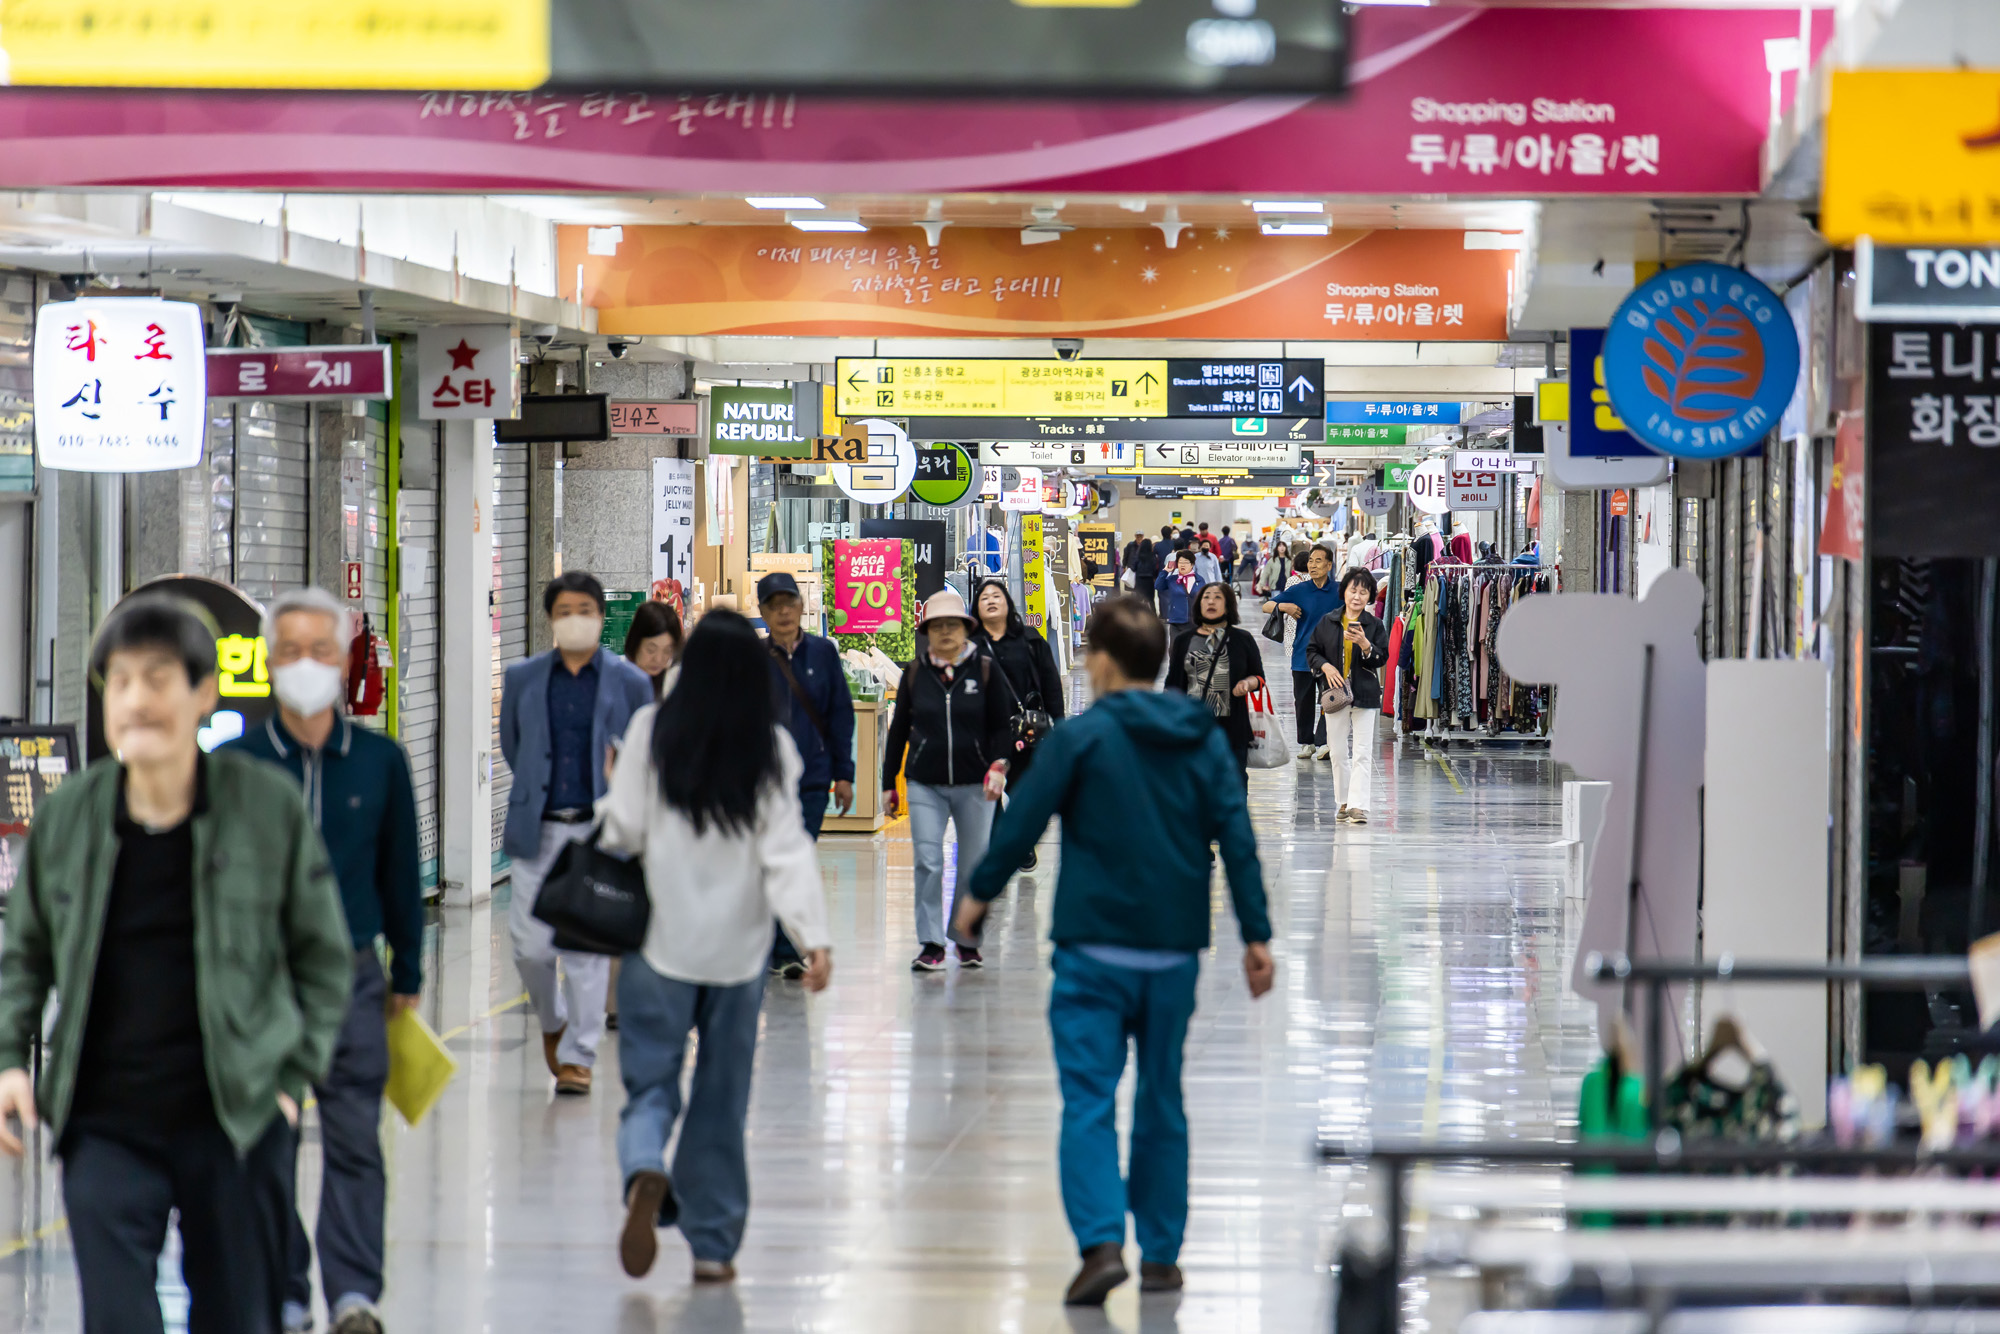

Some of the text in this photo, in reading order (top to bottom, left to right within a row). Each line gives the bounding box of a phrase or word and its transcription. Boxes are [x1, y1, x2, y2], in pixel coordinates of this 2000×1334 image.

[1411, 97, 1616, 126] Shopping Station
[1406, 133, 1660, 176] 두/류/아/울/렛
[756, 245, 943, 274] 이제 패션의 유혹은
[851, 274, 1062, 304] 지하철을 타고 온다!!!
[1326, 283, 1439, 300] Shopping Station
[1627, 273, 1773, 331] global eco
[1323, 303, 1464, 327] 두/류/아/울/렛
[1887, 330, 2000, 382] 토니
[877, 367, 893, 383] 11
[902, 366, 965, 378] 신흥초등학교
[1020, 367, 1106, 378] 광장코아먹자골목
[1201, 364, 1256, 378] 엘리베이터
[432, 377, 496, 408] 스타
[1114, 382, 1127, 396] 7
[877, 391, 893, 407] 12
[902, 390, 944, 401] 두류공원
[1222, 390, 1256, 404] 화장실
[1188, 404, 1208, 412] Toilet
[1364, 404, 1439, 416] 두/류/아/울/렛
[716, 423, 806, 442] REPUBLI
[1039, 424, 1075, 435] Tracks
[1329, 427, 1389, 439] 두/류/아/울/렛
[1288, 432, 1307, 440] 15m
[1031, 451, 1053, 460] Toilet
[1208, 453, 1243, 463] Elevator
[1471, 457, 1516, 469] 아나비
[663, 485, 681, 497] JUICY
[1364, 497, 1388, 509] 타로
[1461, 493, 1488, 502] 레이나
[664, 500, 681, 512] JELLY
[1084, 538, 1108, 551] 전자
[753, 557, 785, 565] BEAUTY
[850, 555, 885, 566] MEGA
[850, 565, 885, 577] SALE
